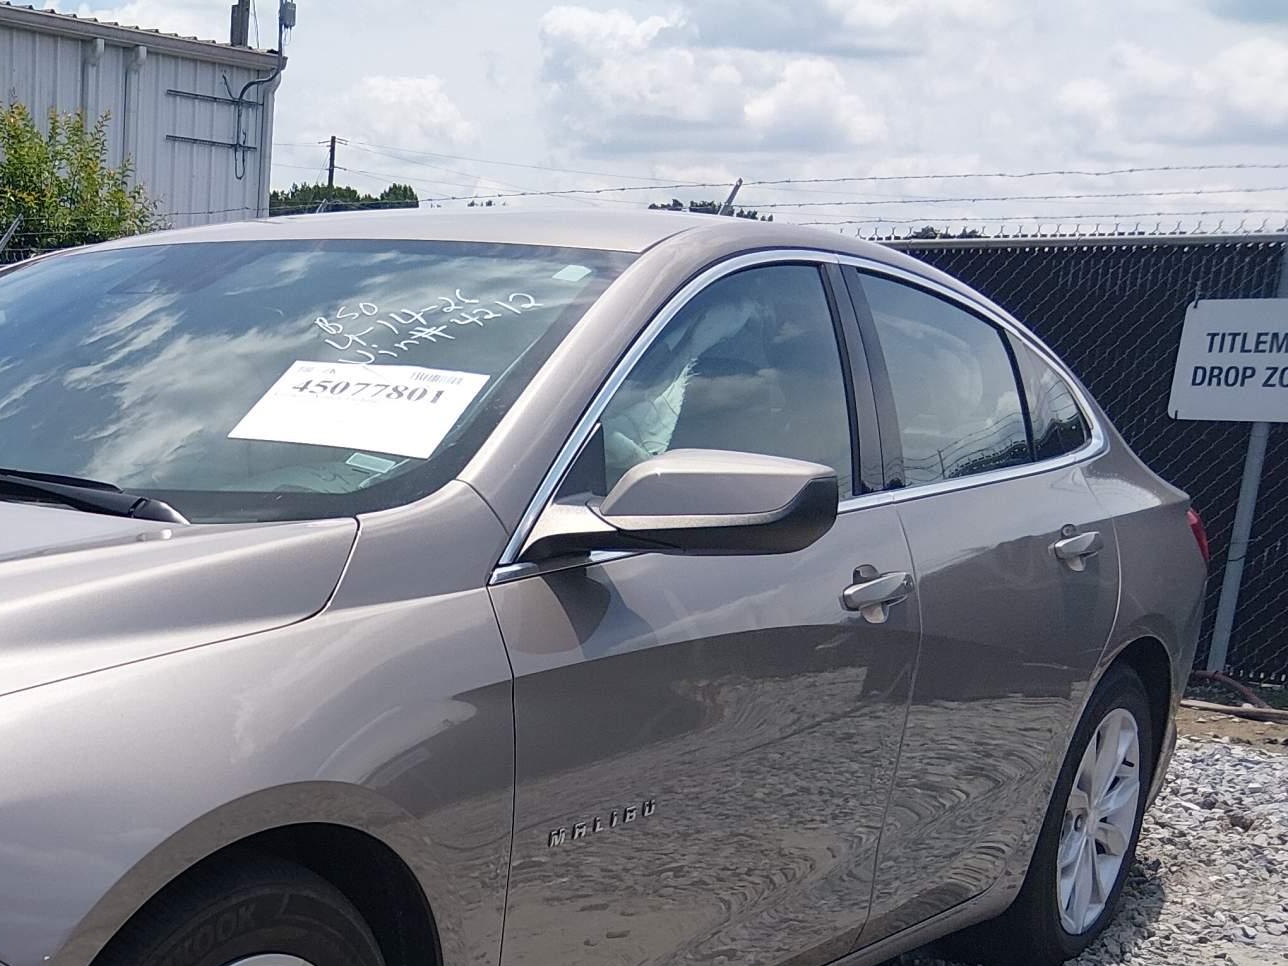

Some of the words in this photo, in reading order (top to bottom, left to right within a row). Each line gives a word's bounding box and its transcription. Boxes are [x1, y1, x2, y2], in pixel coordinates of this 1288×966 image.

[1192, 366, 1256, 387] DROP
[292, 379, 445, 404] 45077801
[547, 800, 655, 848] MALIBU
